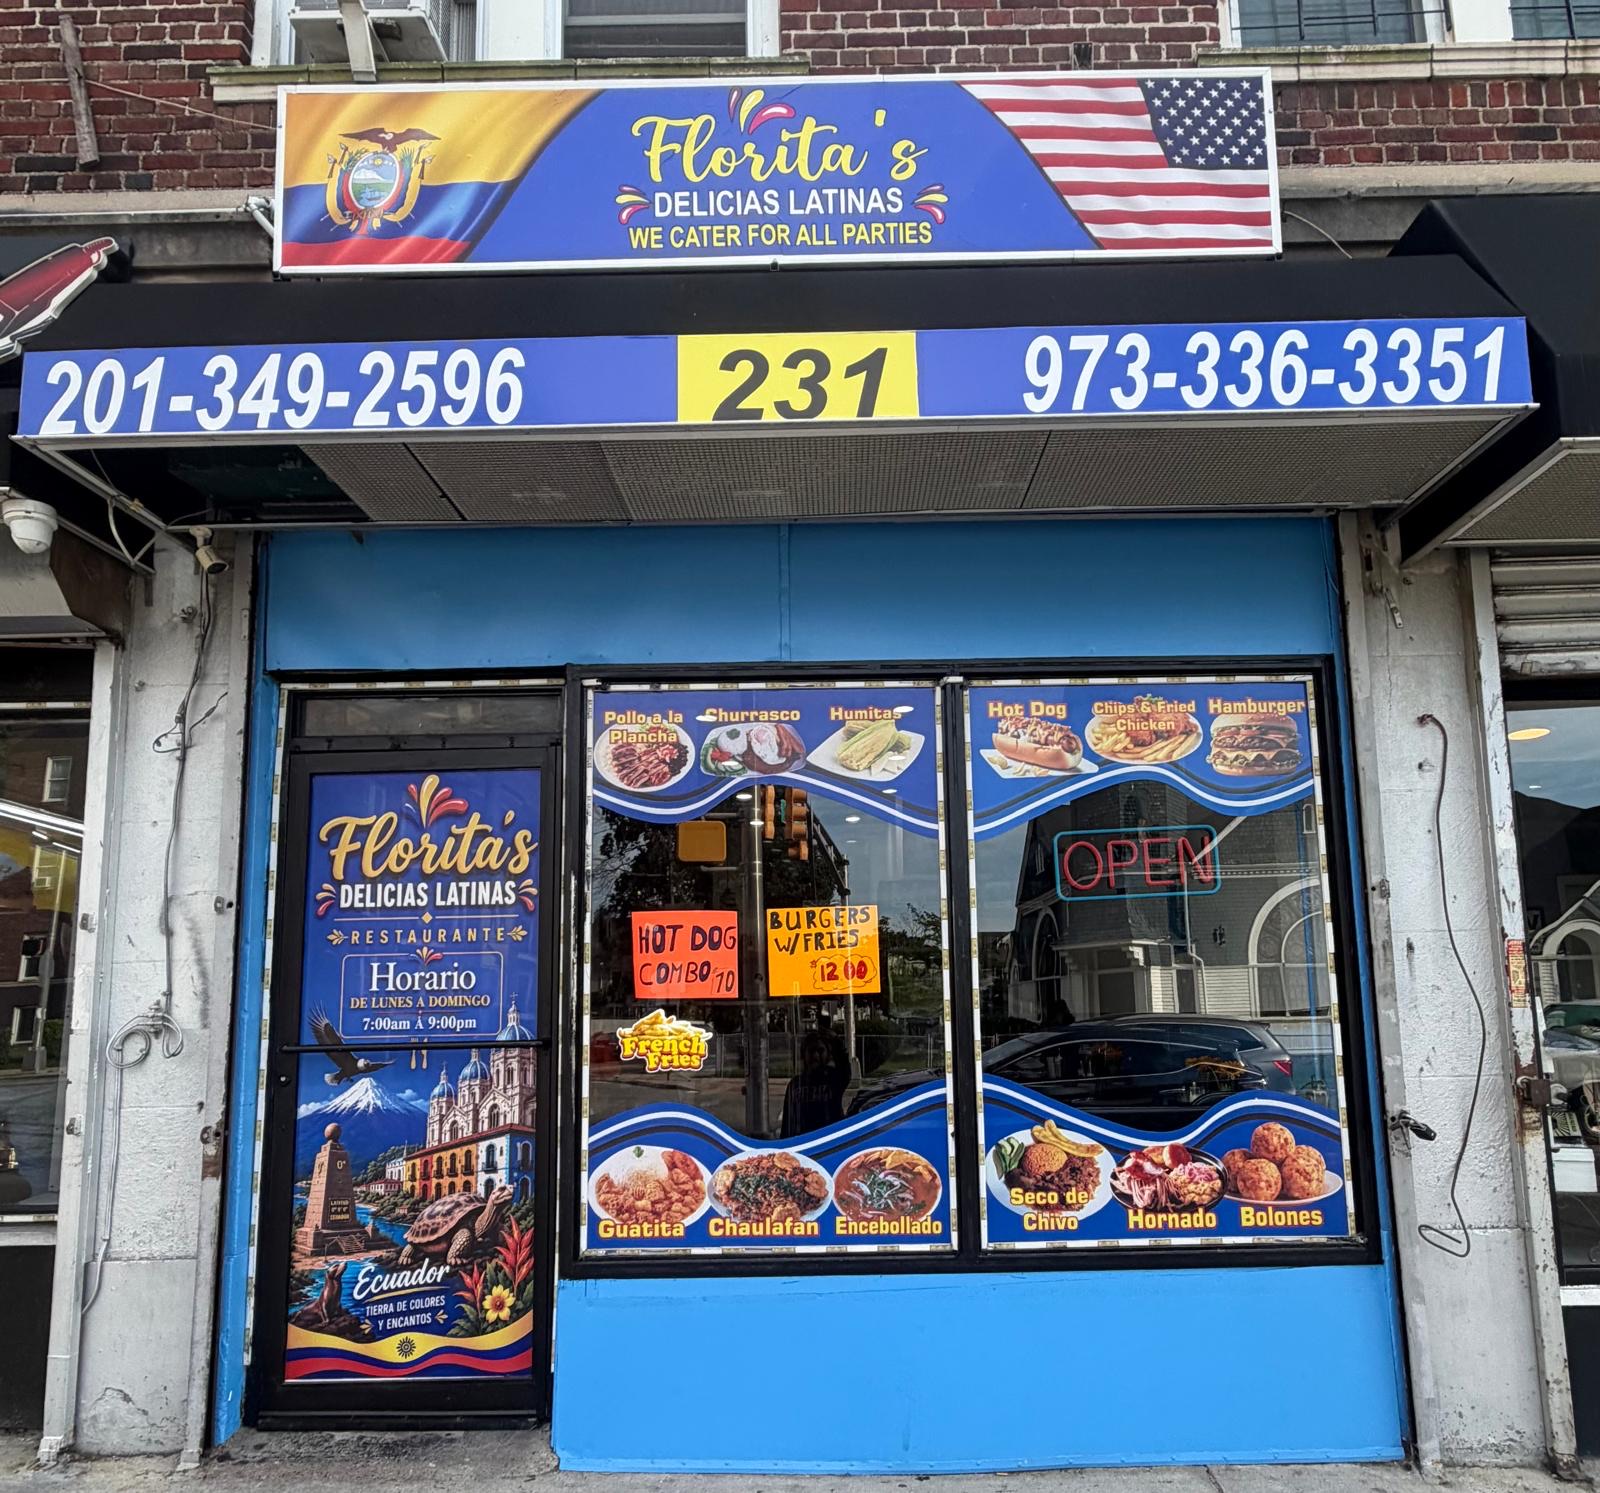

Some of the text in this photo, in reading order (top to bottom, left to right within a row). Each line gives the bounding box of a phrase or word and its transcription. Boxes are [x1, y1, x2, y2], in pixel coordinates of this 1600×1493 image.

[631, 109, 928, 182] Florita's
[654, 187, 902, 217] DELICIAS LATINAS
[629, 222, 932, 249] WE CATER FOR ALL PARTIES
[1023, 326, 1505, 413] 973-336-3351
[39, 347, 525, 435] 201-349-2596
[712, 347, 888, 421] 231
[705, 708, 801, 723] Churrasco
[830, 707, 902, 721] Humitas
[988, 702, 1067, 720] Hot Dog
[1093, 701, 1196, 716] Chips & Fried
[1209, 699, 1305, 716] Hamburger
[604, 711, 683, 725] Pollo a la
[1116, 719, 1175, 731] Chicken
[610, 730, 677, 744] Plancha
[319, 810, 538, 880] Florita's
[1063, 836, 1213, 890] OPEN
[340, 881, 516, 908] DELICIAS LATINAS
[770, 907, 871, 930] BURGERS
[351, 927, 505, 944] RESTAURANTE
[638, 924, 736, 954] HOT DOG
[774, 928, 859, 955] W/FRIES
[369, 962, 476, 992] Horario
[640, 961, 711, 985] COMBO
[350, 995, 491, 1009] DE LUNES A DOMINGO
[362, 1018, 410, 1030] 7:00am
[428, 1016, 477, 1031] 9:00pm
[620, 1036, 706, 1058] French
[647, 1053, 702, 1070] Fries
[1010, 1187, 1088, 1205] Seco de
[835, 1216, 942, 1235] Encebollado
[1023, 1212, 1078, 1231] Chivo
[1128, 1209, 1217, 1229] Hornado
[1240, 1206, 1323, 1227] Bolones
[598, 1220, 685, 1238] Guatita
[708, 1217, 819, 1237] Chaulafan
[353, 1258, 450, 1300] Ecuador
[366, 1295, 445, 1316] TIERRA DE COLORES
[378, 1313, 432, 1331] Y ENCANTOS
